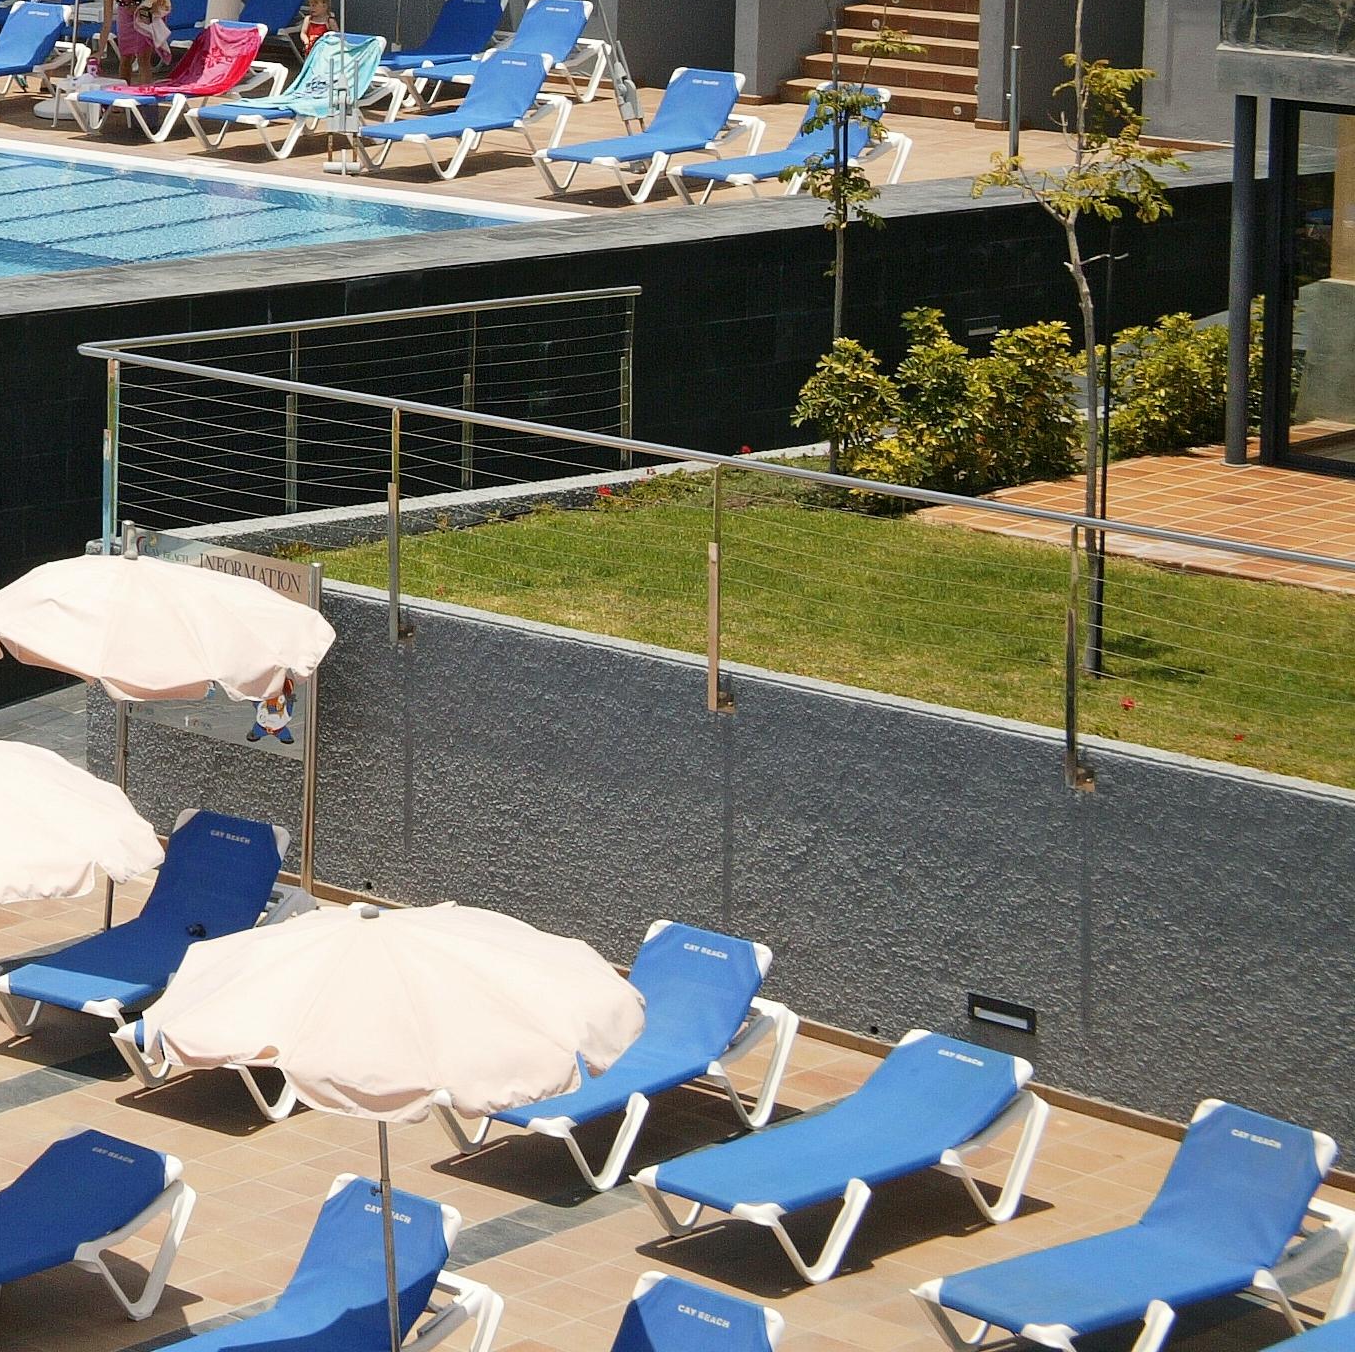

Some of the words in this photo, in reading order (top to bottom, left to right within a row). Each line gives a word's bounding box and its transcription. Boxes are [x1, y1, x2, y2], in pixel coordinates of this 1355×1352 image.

[200, 553, 302, 593] INFORMATION
[210, 829, 225, 838] CAY
[225, 832, 251, 845] BEACH
[677, 1304, 697, 1317] CAY
[697, 1311, 731, 1329] BEACH
